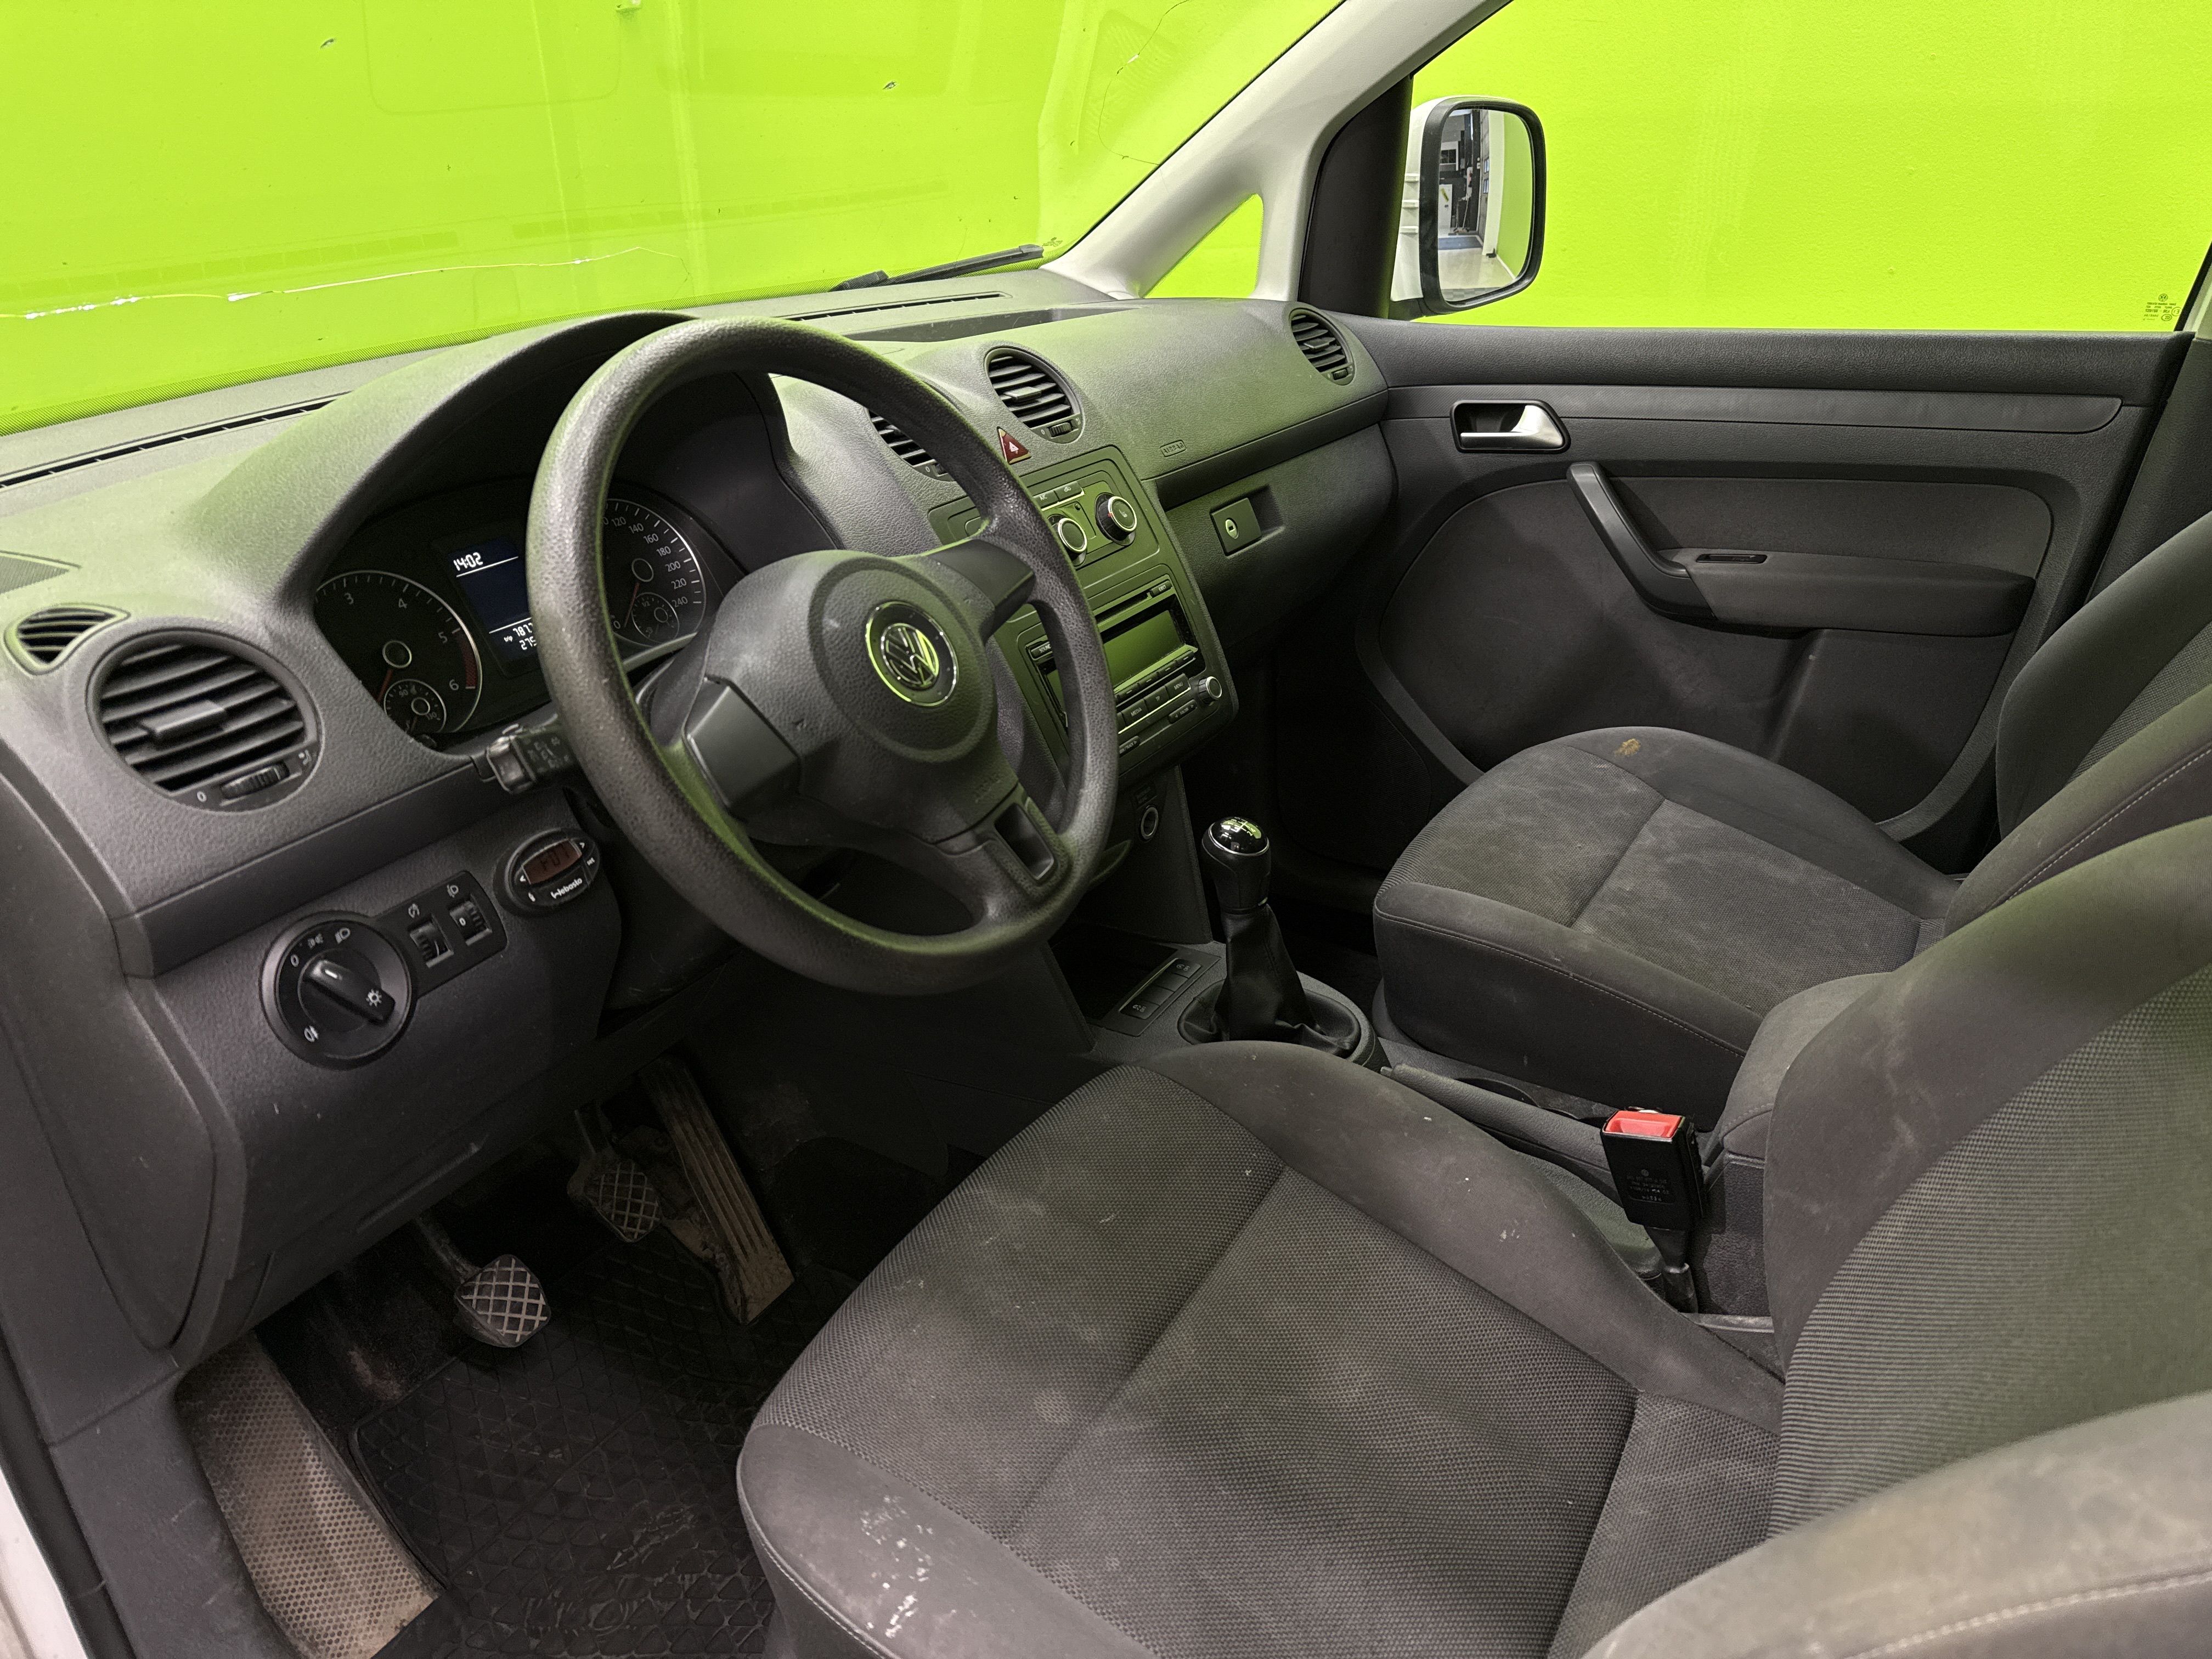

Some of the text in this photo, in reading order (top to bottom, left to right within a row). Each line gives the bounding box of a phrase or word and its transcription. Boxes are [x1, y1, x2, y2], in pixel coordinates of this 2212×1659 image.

[612, 517, 626, 527] 120
[629, 523, 644, 534] 140
[643, 533, 659, 544] 160
[656, 546, 671, 557] 180
[453, 552, 483, 571] 14:02
[665, 561, 681, 572] 200
[671, 578, 687, 589] 220
[344, 592, 354, 604] 3
[398, 597, 408, 609] 4
[672, 596, 688, 608] 240
[438, 631, 448, 644] 5
[449, 679, 459, 691] 6
[550, 878, 583, 899] Webasto
